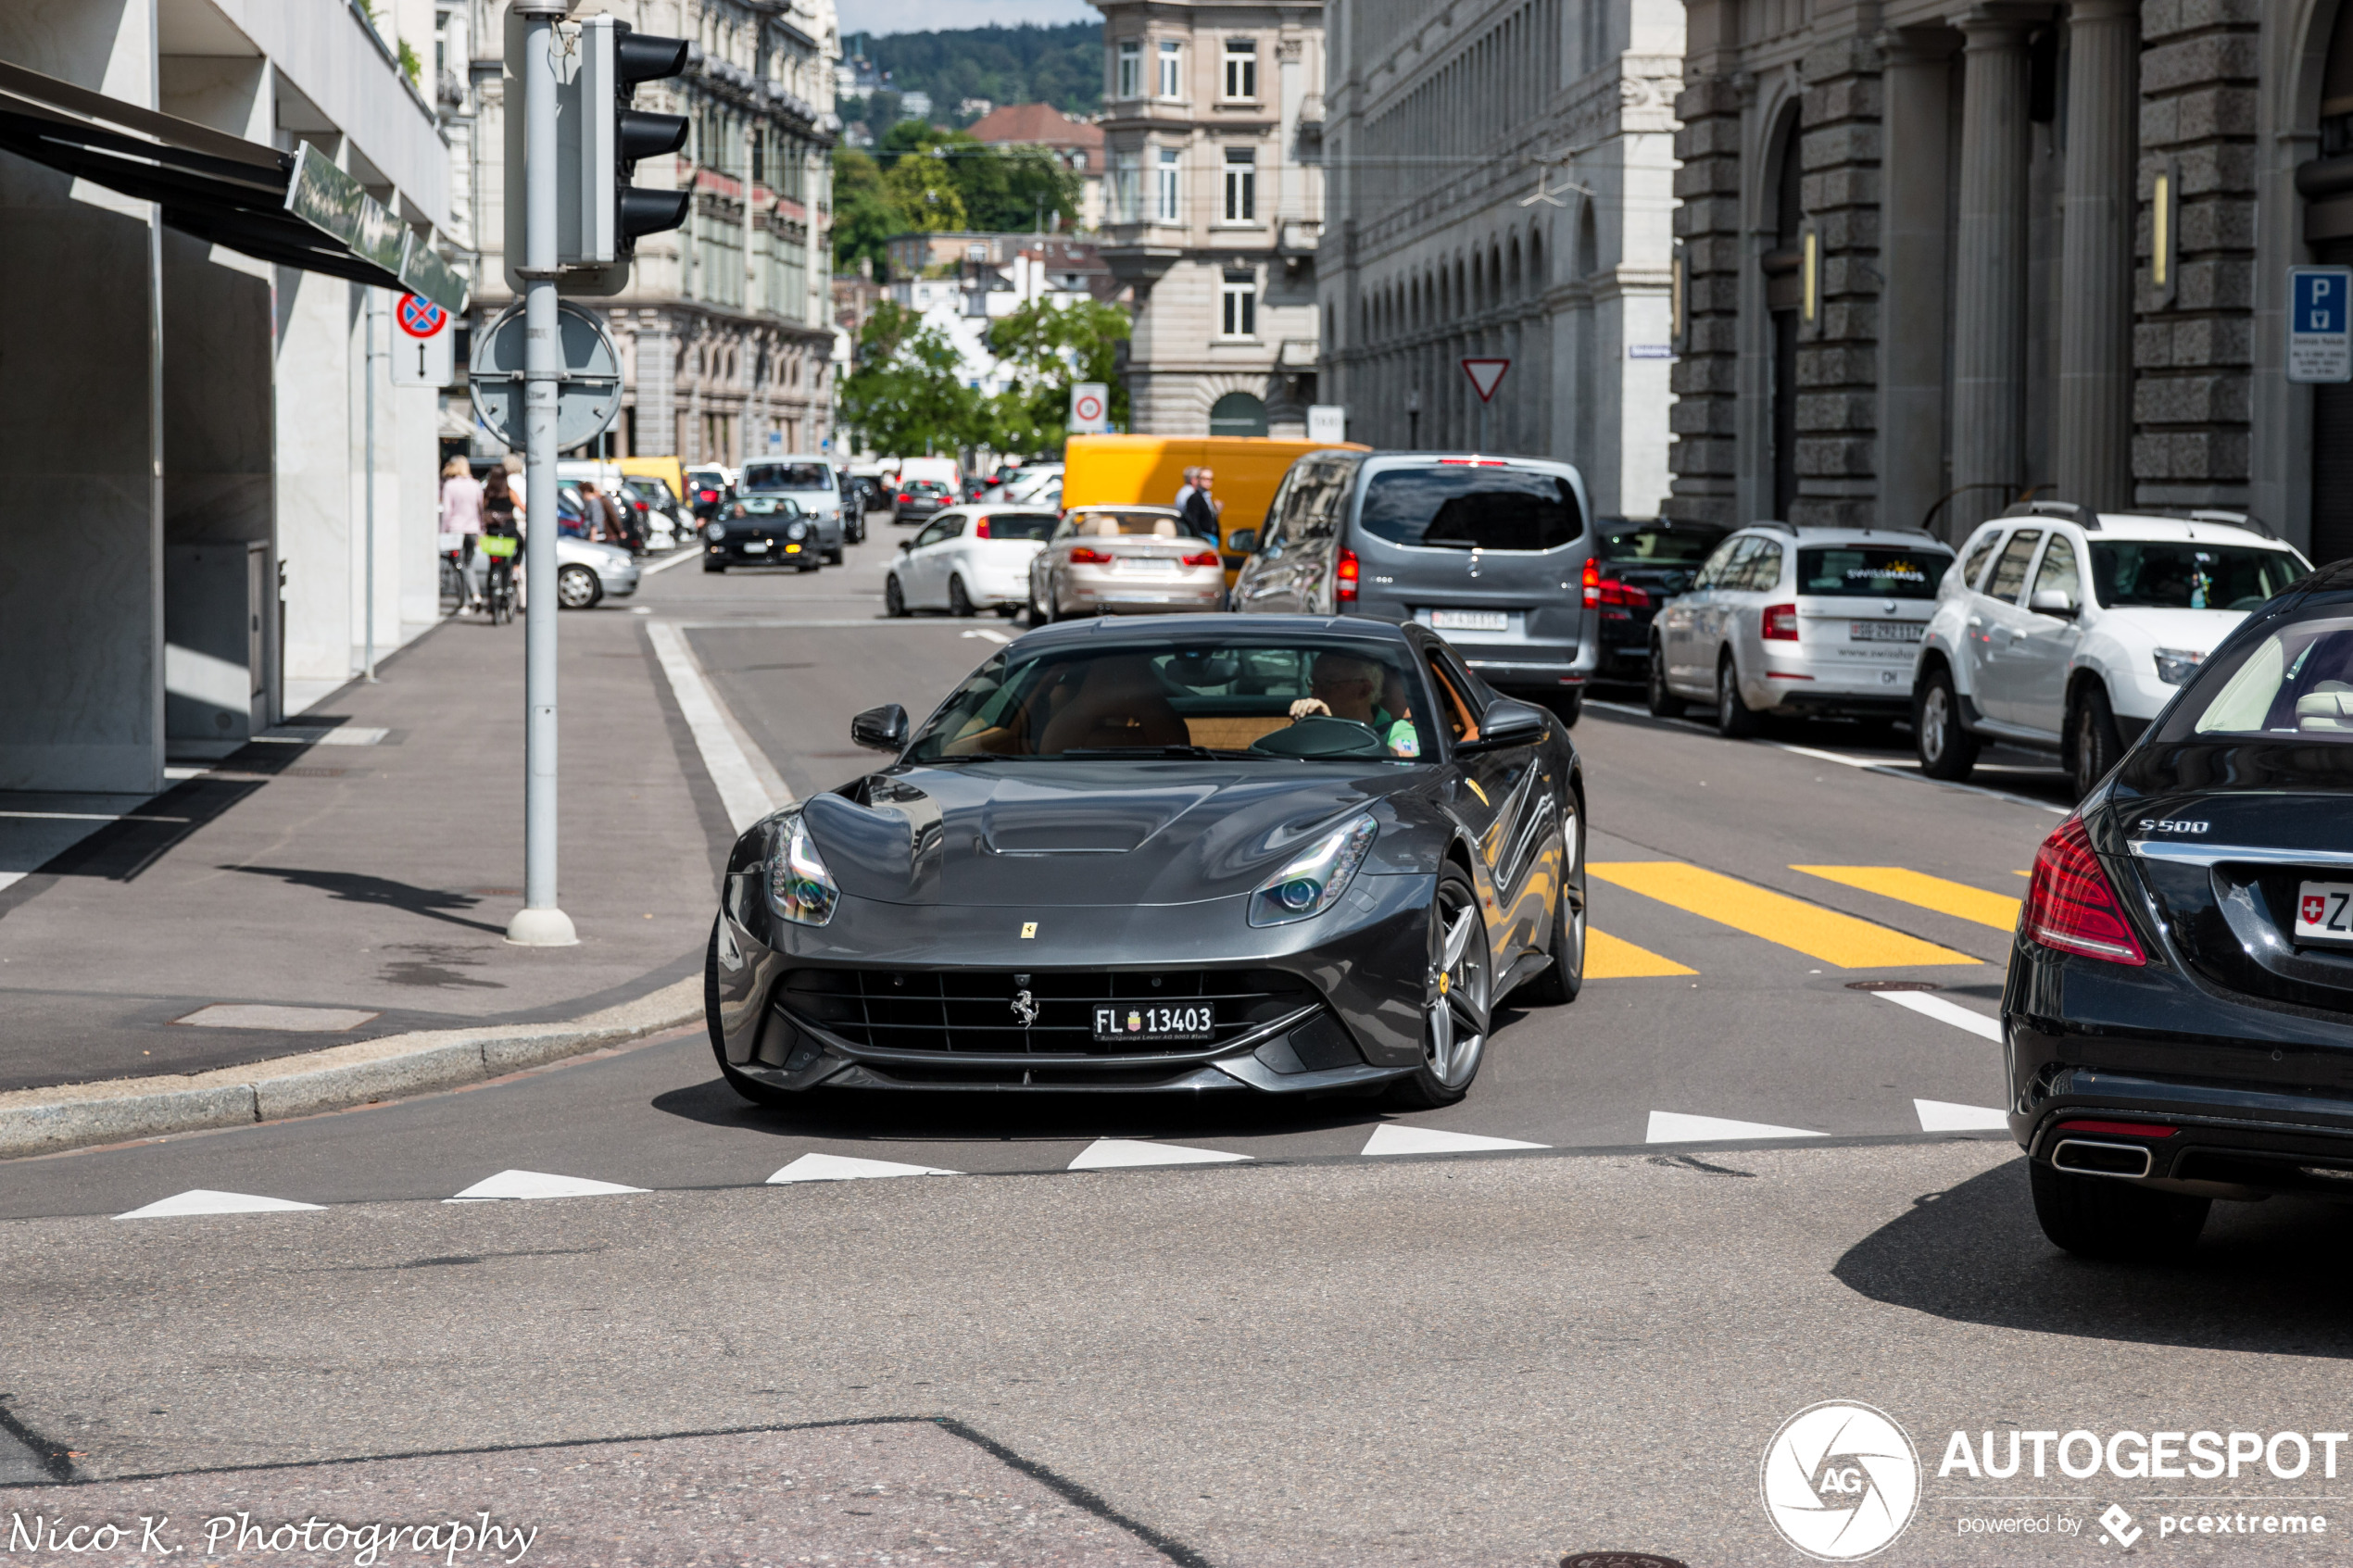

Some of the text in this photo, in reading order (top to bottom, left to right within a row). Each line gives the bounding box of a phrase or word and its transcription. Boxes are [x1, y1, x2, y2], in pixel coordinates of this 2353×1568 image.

[2312, 279, 2330, 306] P
[1096, 1008, 1212, 1034] FL 13403
